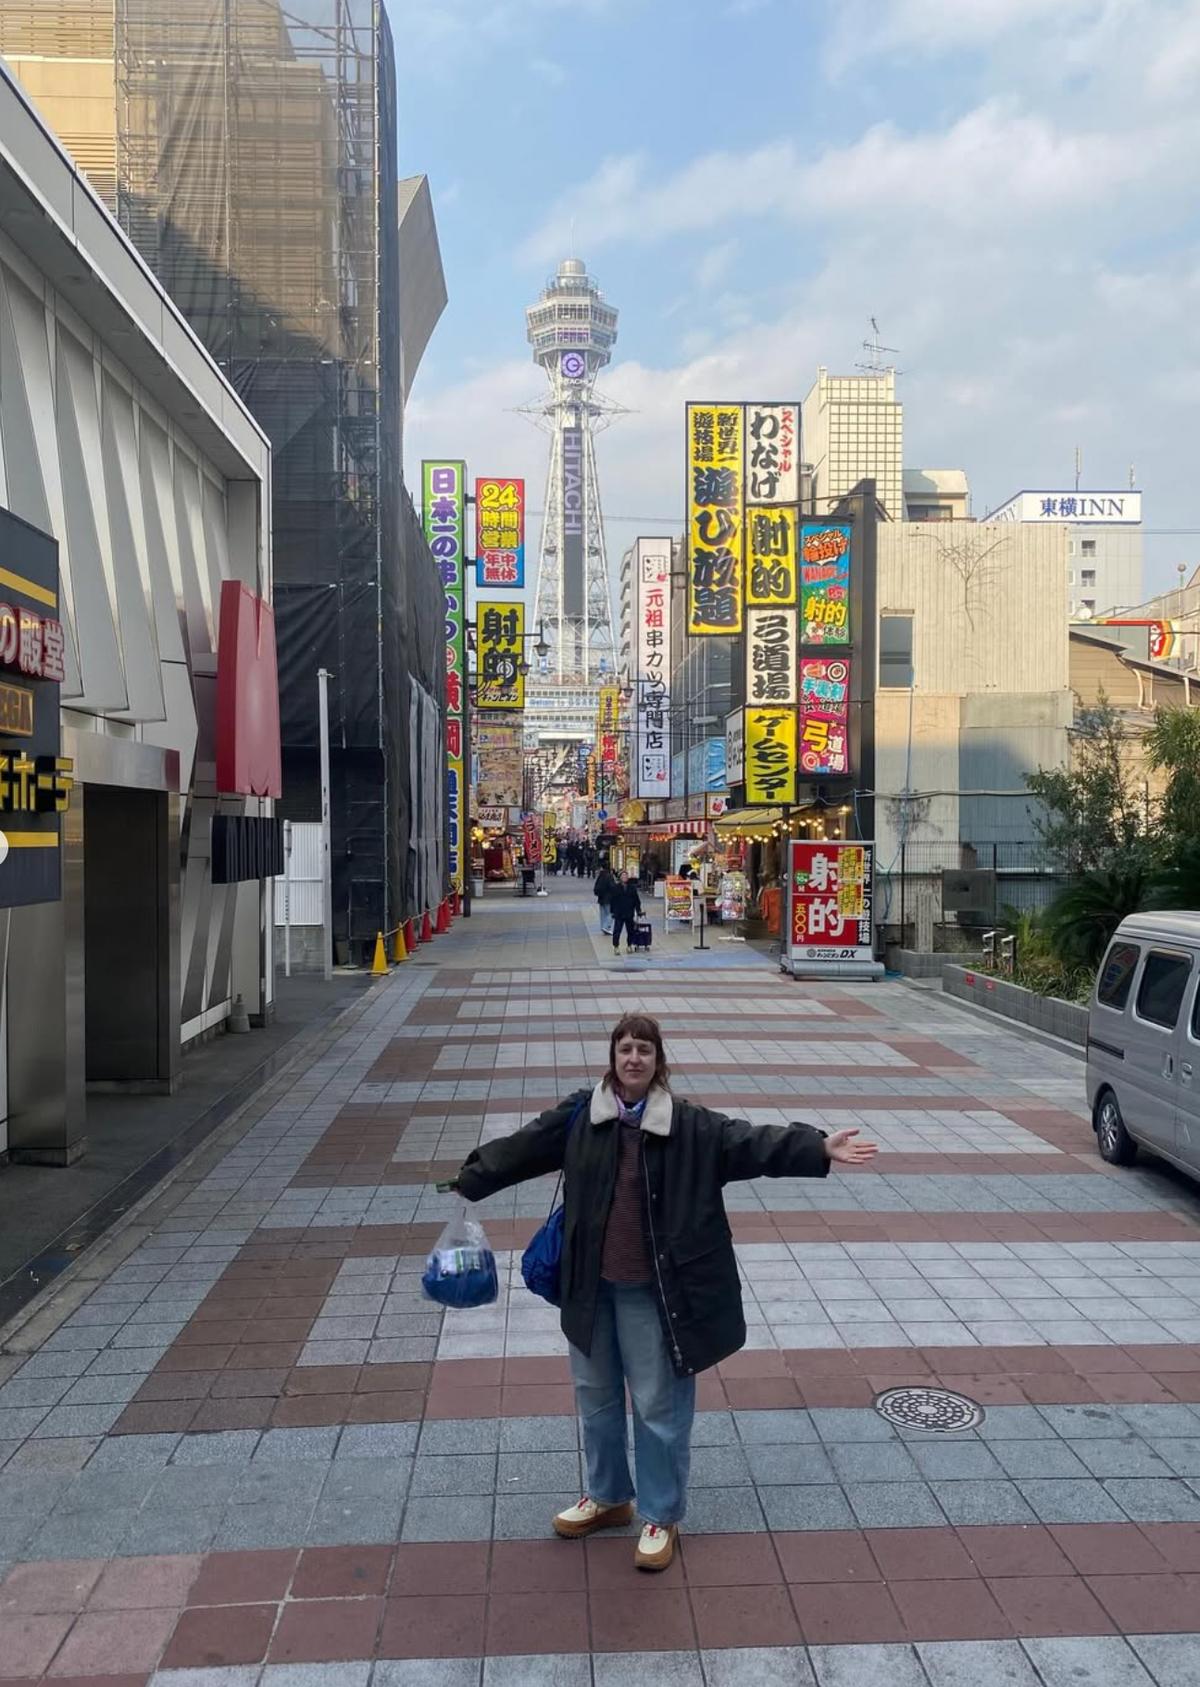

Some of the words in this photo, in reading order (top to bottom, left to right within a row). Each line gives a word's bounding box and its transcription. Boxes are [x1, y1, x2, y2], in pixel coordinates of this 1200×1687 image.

[750, 411, 781, 499] わなげ
[778, 409, 793, 473] スペシャル
[480, 483, 520, 509] 24
[564, 433, 582, 535] HITACHI
[1040, 497, 1125, 517] 東横INN
[692, 466, 740, 627] 遊び放題
[752, 514, 791, 598] 射的
[804, 597, 846, 626] 射的
[752, 713, 791, 800] ゲームセンター
[840, 949, 857, 959] DX
